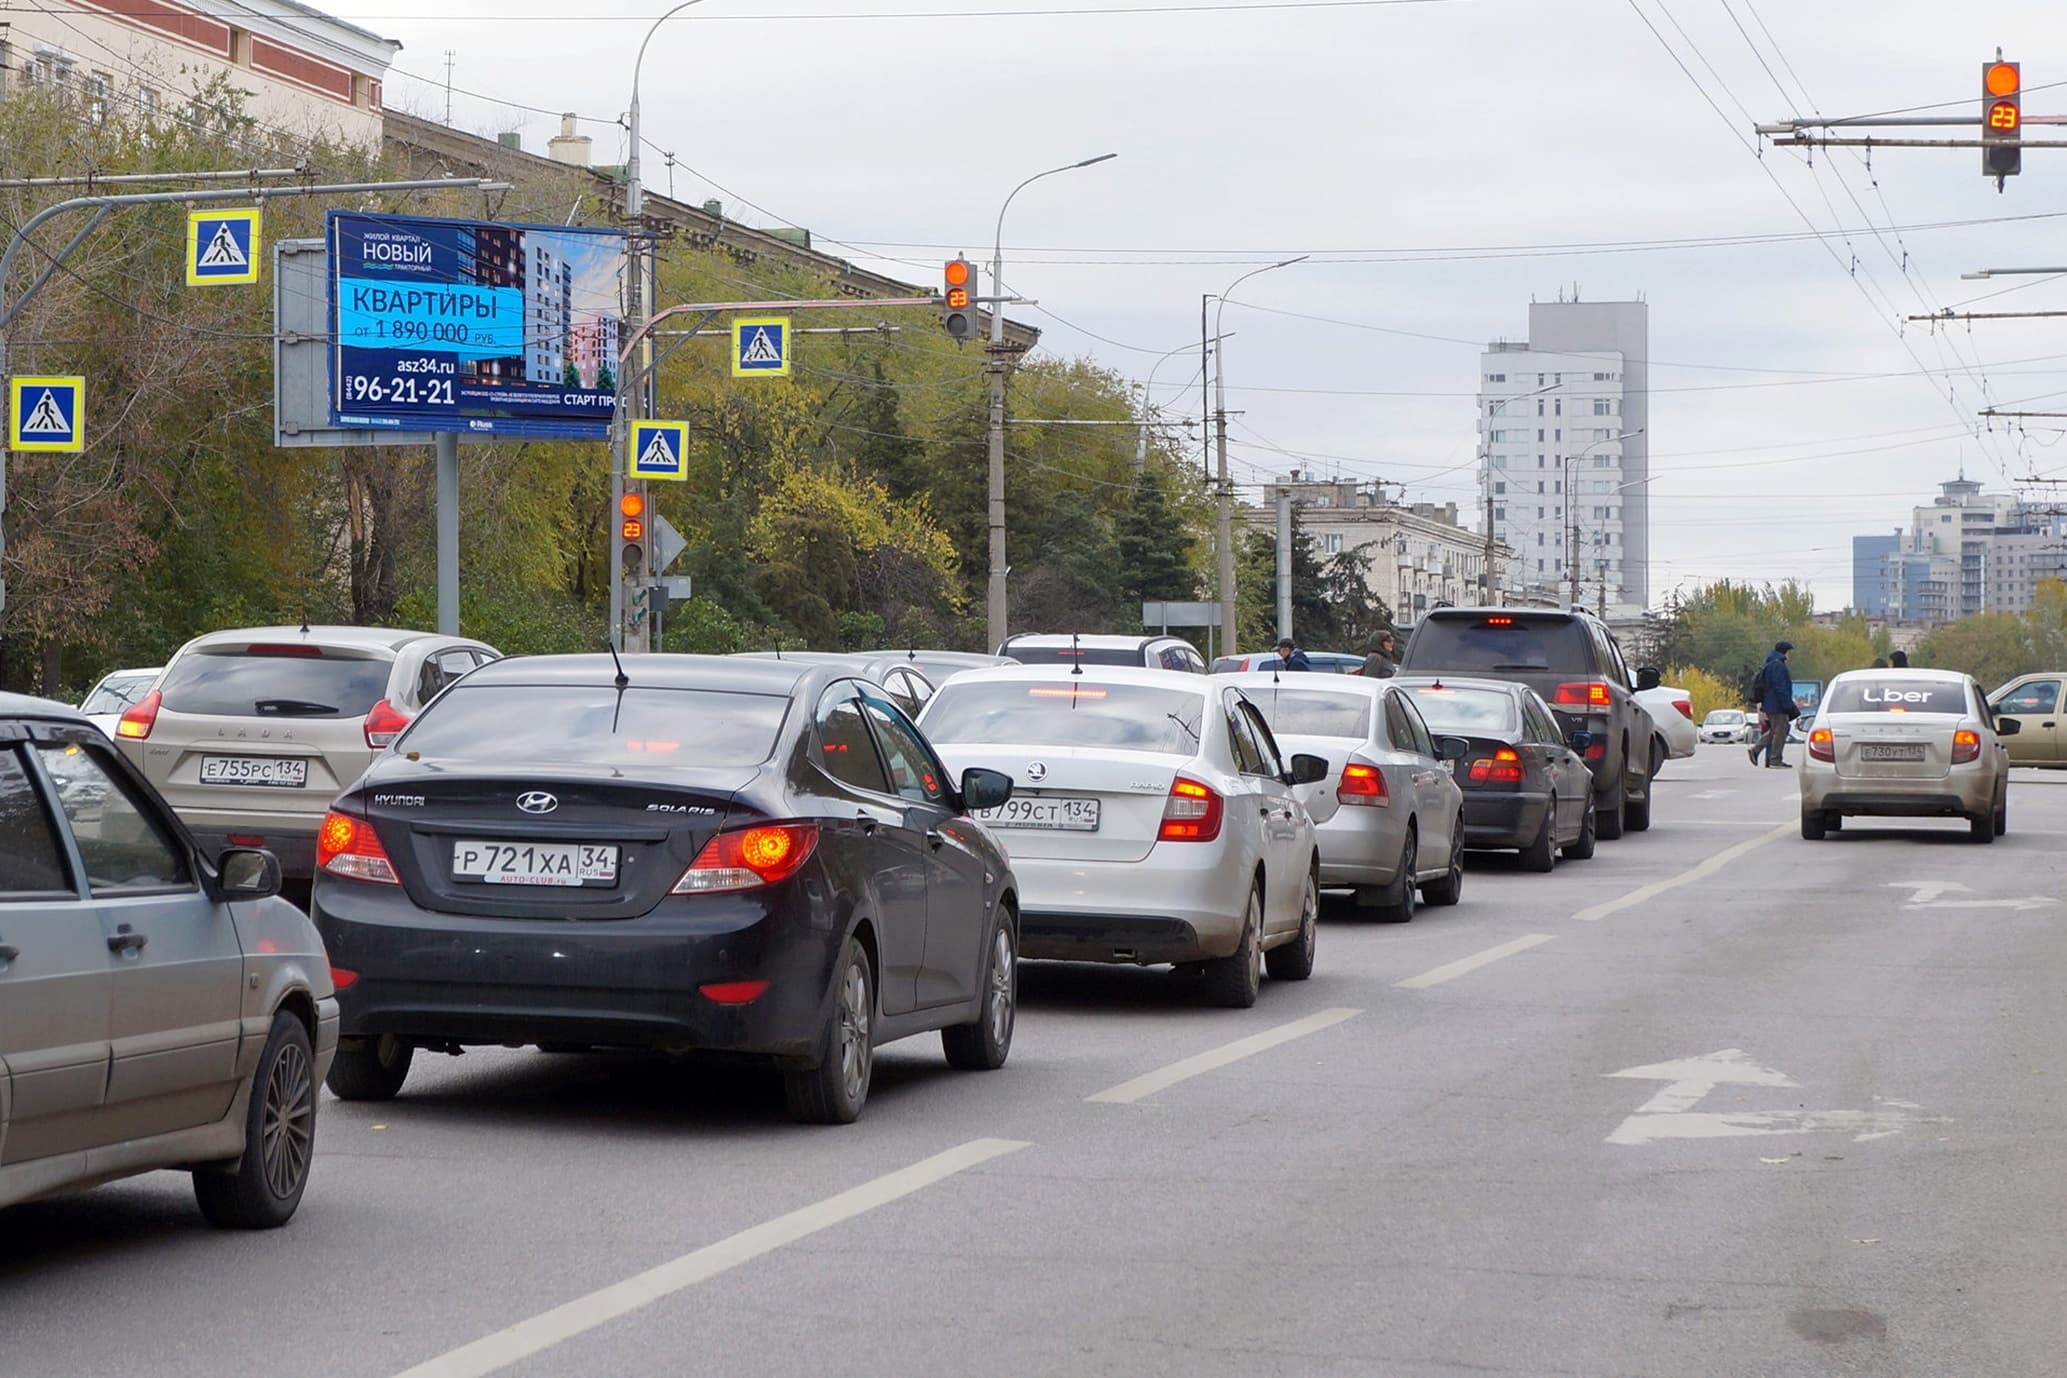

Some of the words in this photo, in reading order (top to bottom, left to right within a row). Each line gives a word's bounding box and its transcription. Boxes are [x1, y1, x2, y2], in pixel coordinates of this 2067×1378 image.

[1991, 106, 2016, 128] 23
[363, 232, 390, 241] ЖИЛОЙ
[391, 234, 421, 243] КВАРТАЛ
[363, 242, 432, 263] НОВЫЙ
[353, 288, 497, 319] КВАРТИРЫ
[950, 291, 967, 307] 23
[397, 357, 455, 374] asz34.ru
[354, 374, 455, 405] 96-21-21
[564, 393, 598, 406] СТАРТ
[624, 522, 640, 537] 23
[275, 761, 300, 775] 134
[374, 794, 425, 806] HYUNDAI
[646, 803, 716, 816] SOLARIS
[1064, 801, 1093, 817] 134
[581, 847, 608, 869] 34
